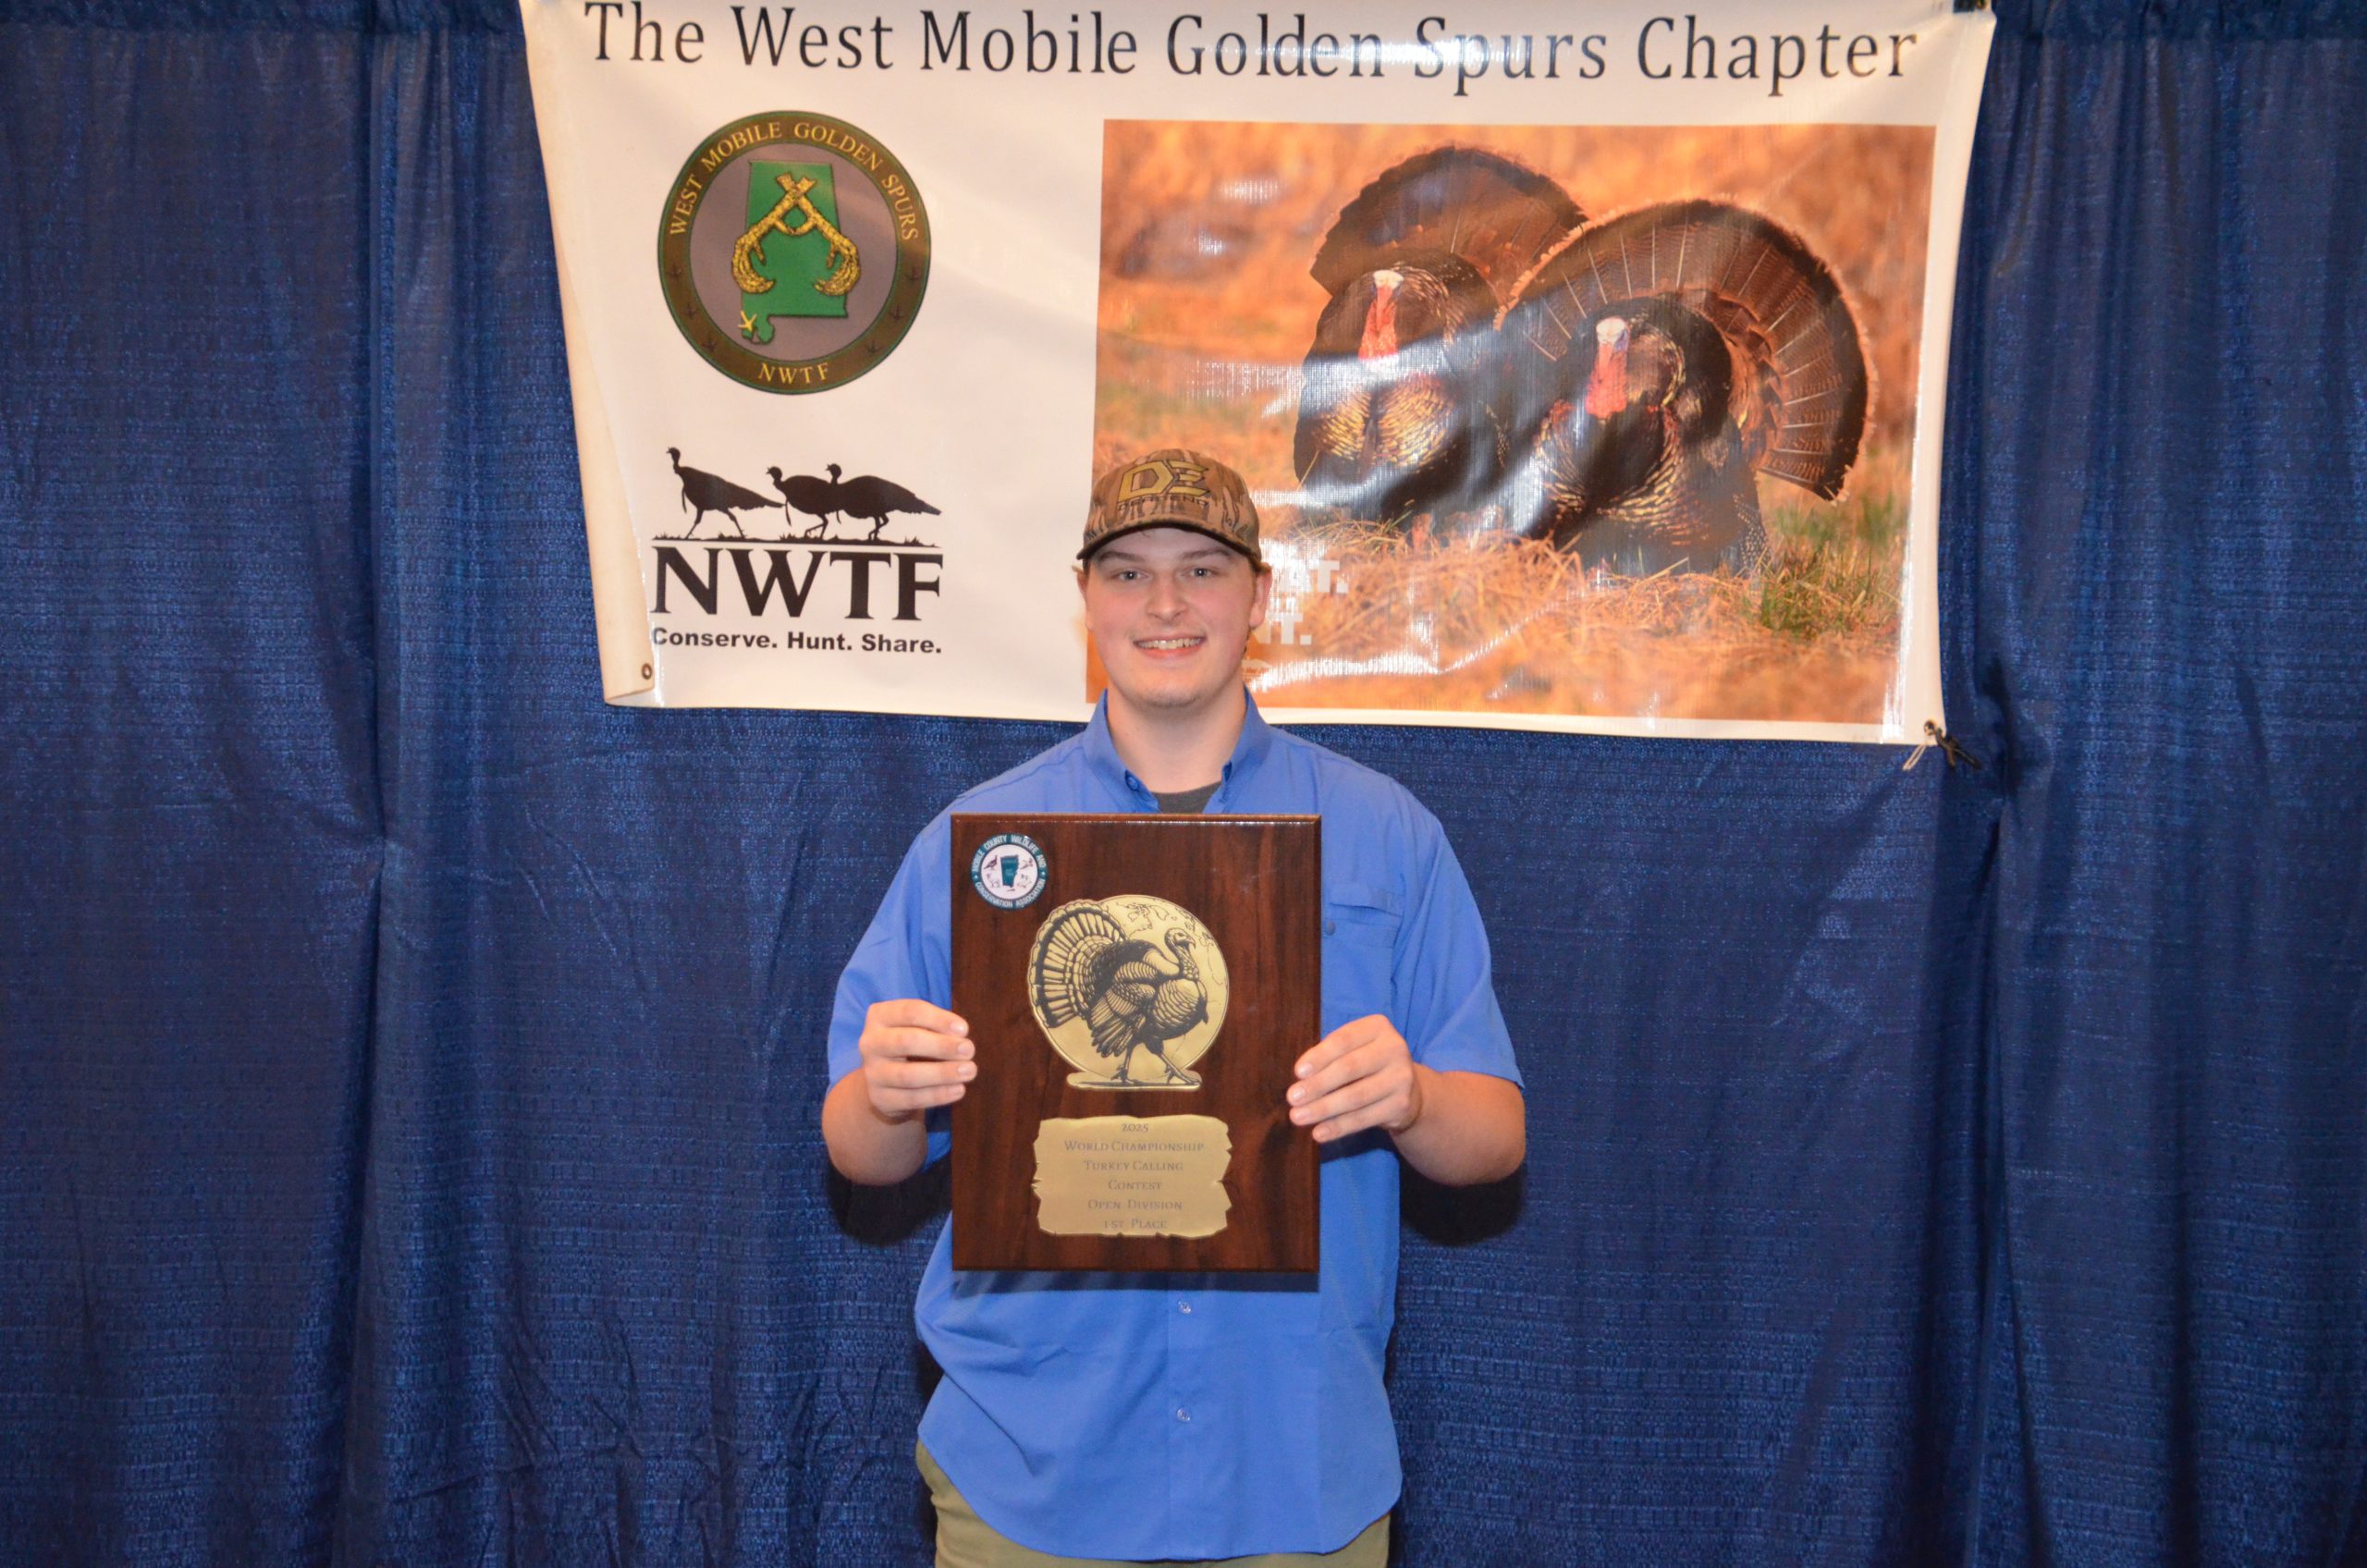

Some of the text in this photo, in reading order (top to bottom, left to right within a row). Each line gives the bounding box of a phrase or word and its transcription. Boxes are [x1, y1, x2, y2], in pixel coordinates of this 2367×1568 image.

[583, 1, 1917, 97] The West Mobile Golden Spurs Chapter
[669, 121, 919, 240] WEST MOBILE GOLDEN SPURS
[757, 362, 830, 386] NWTF
[650, 545, 944, 621] NWTF
[652, 627, 942, 654] Conserve. Hunt. Share.
[983, 835, 1008, 851] COUNTY
[1011, 834, 1040, 855] WILDLIFE
[1015, 878, 1047, 909] ASSOCIATION
[1121, 1122, 1149, 1133] 2025
